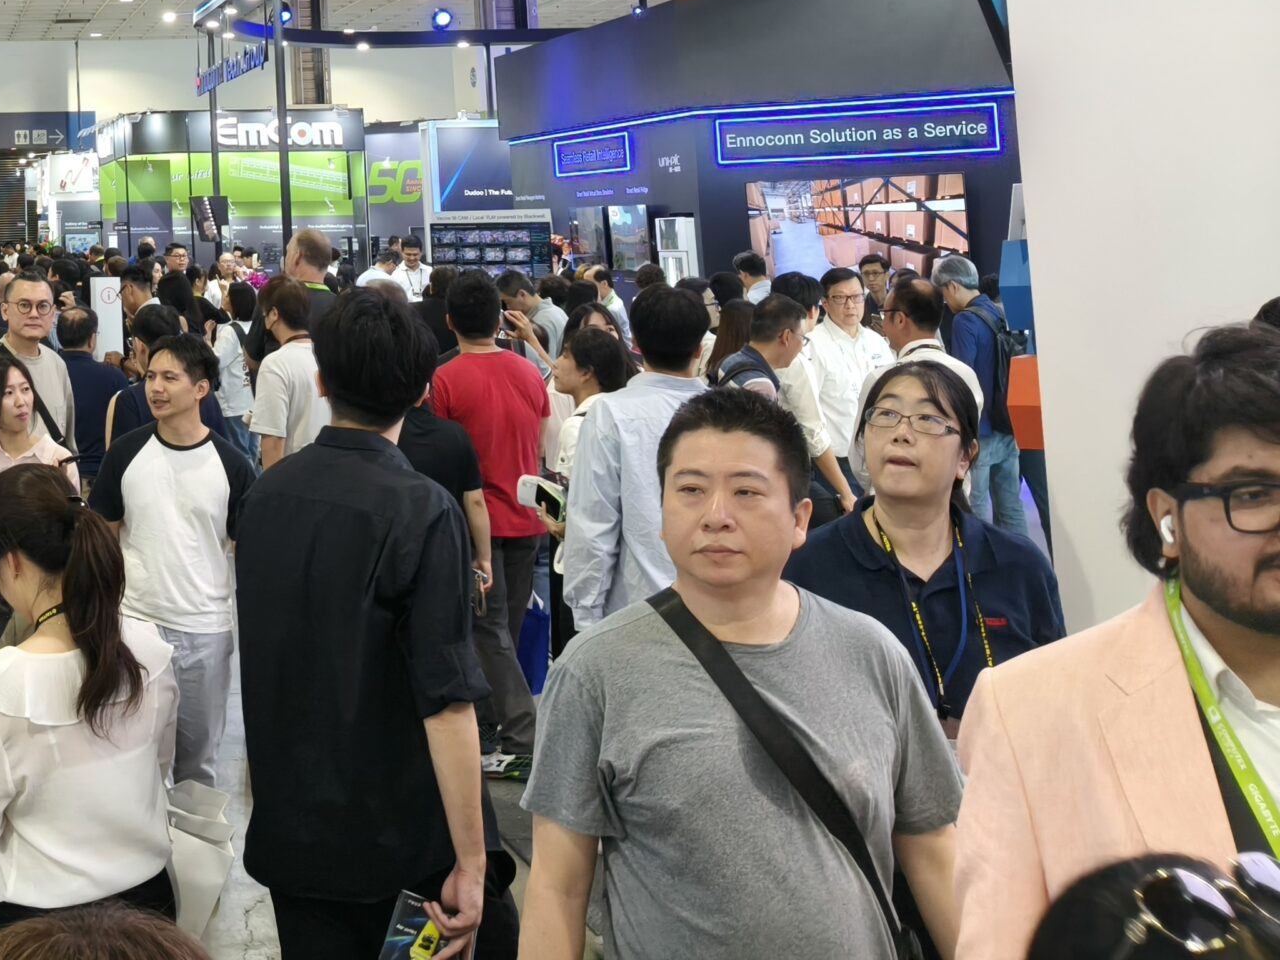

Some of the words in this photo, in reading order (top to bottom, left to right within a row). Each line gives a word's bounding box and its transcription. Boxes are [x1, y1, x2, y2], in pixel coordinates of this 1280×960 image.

[726, 133, 804, 148] Ennoconn
[810, 127, 877, 144] Solution
[883, 128, 902, 140] as
[908, 128, 918, 139] a
[923, 120, 987, 137] Service
[1249, 783, 1280, 837] GIGABYTE
